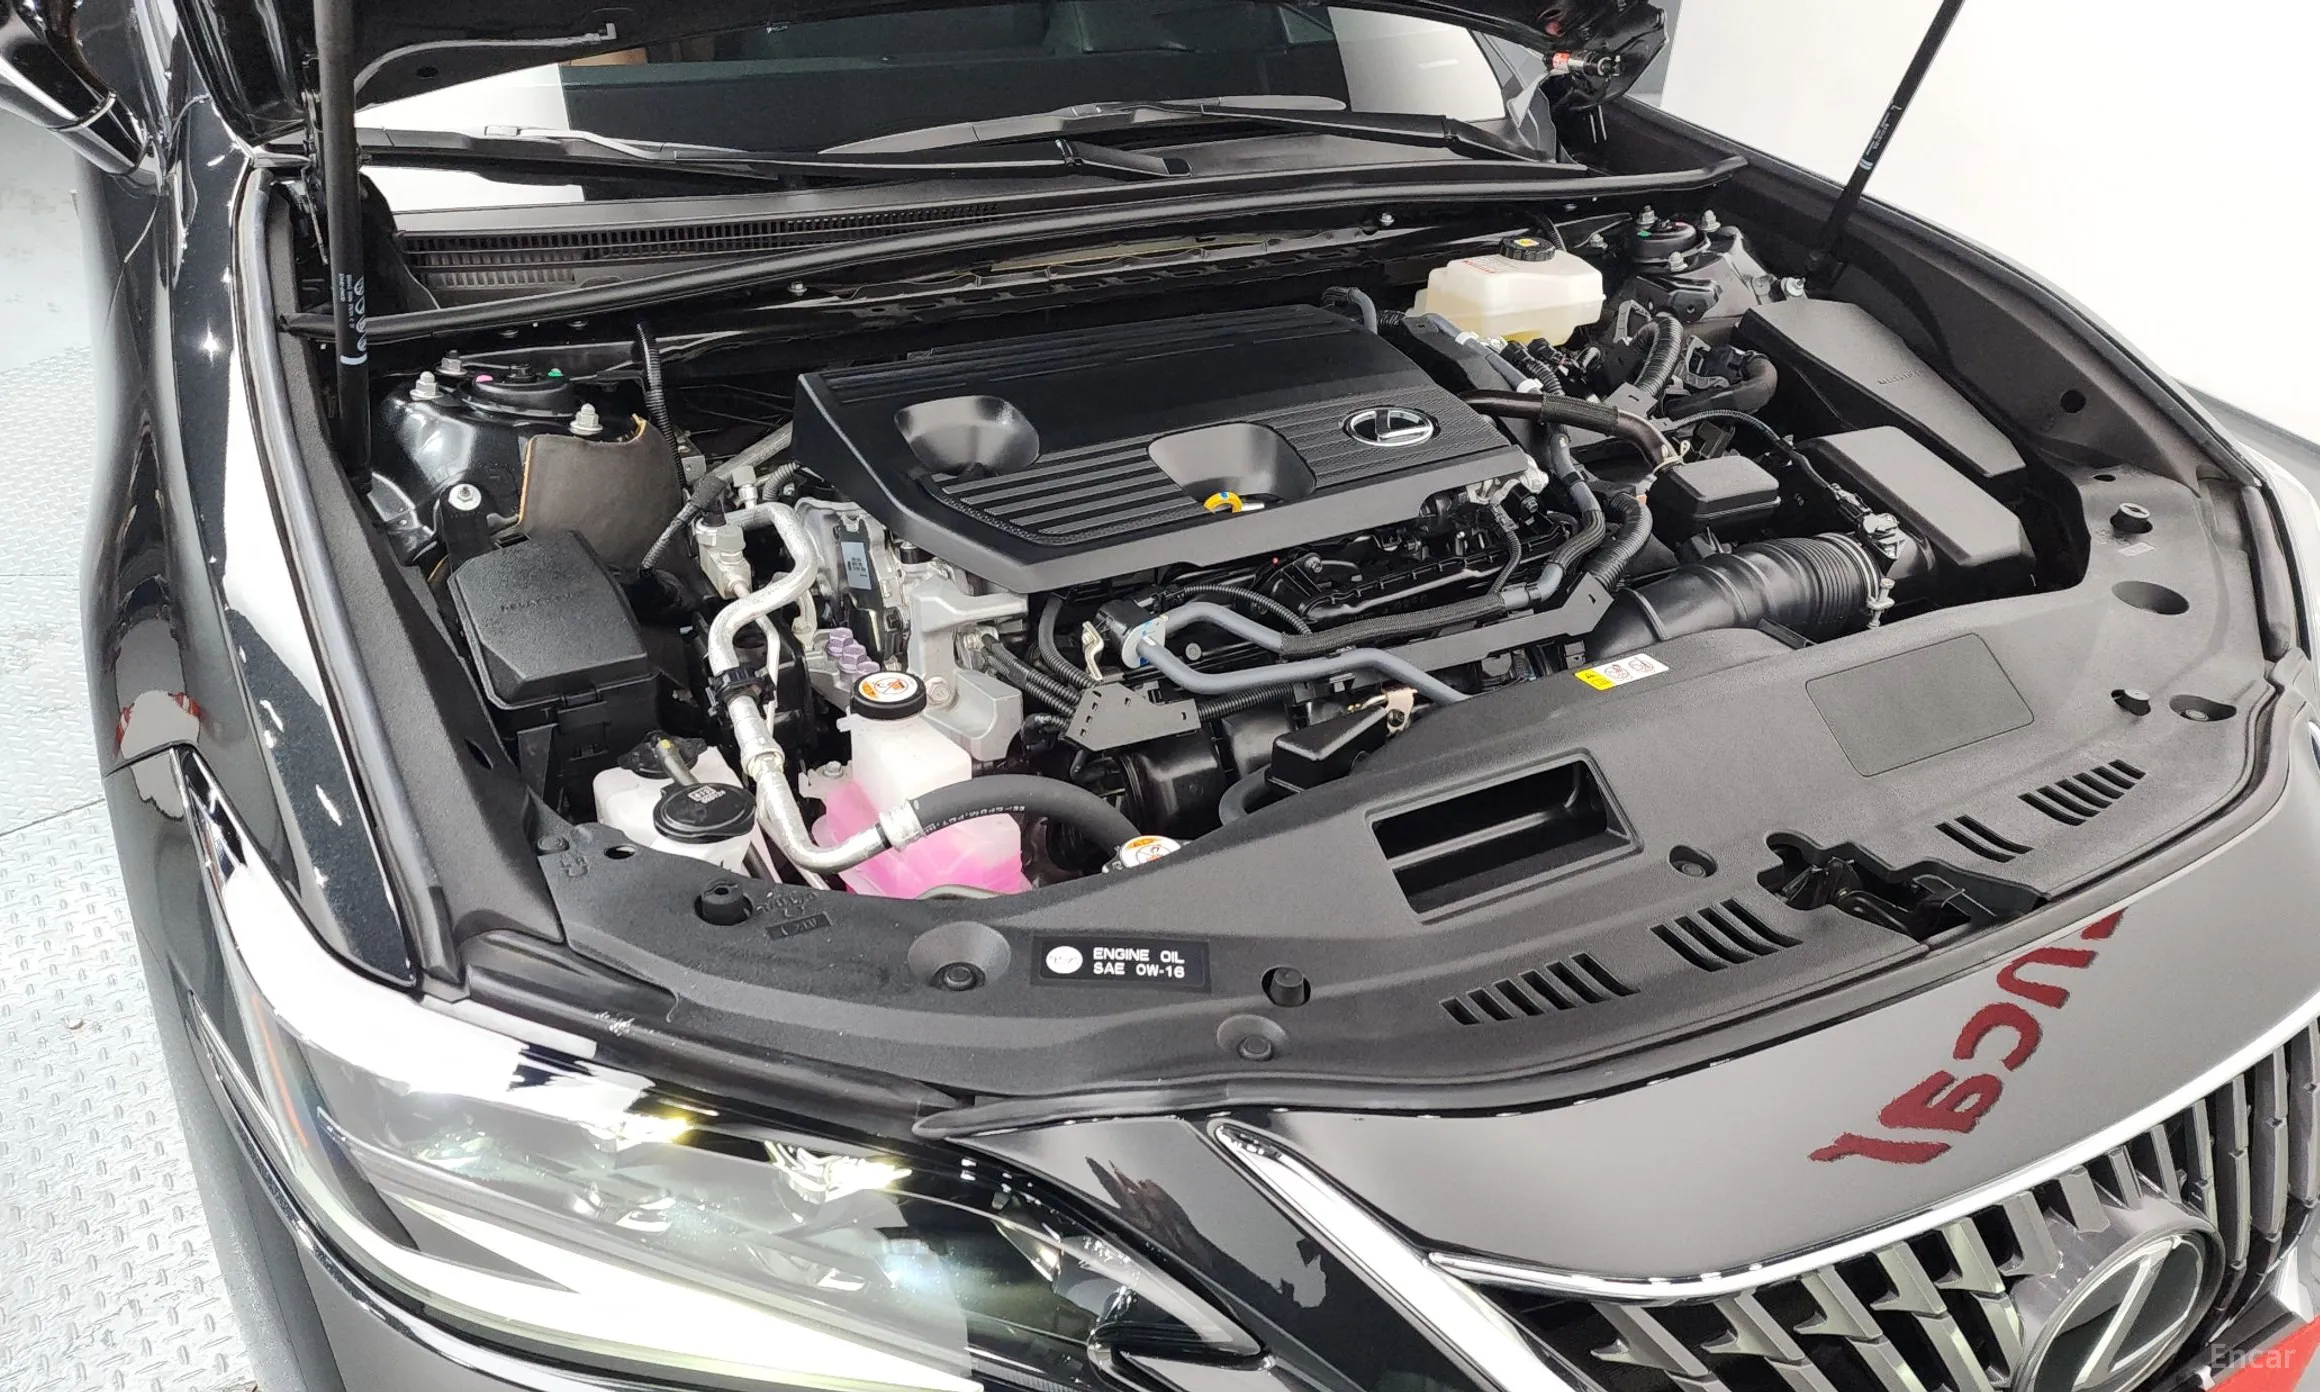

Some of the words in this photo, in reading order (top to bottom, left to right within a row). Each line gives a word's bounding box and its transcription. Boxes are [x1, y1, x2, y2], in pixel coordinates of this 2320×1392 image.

[1093, 947, 1150, 962] ENGINE
[1160, 950, 1186, 964] OIL
[1093, 961, 1126, 975] SAE
